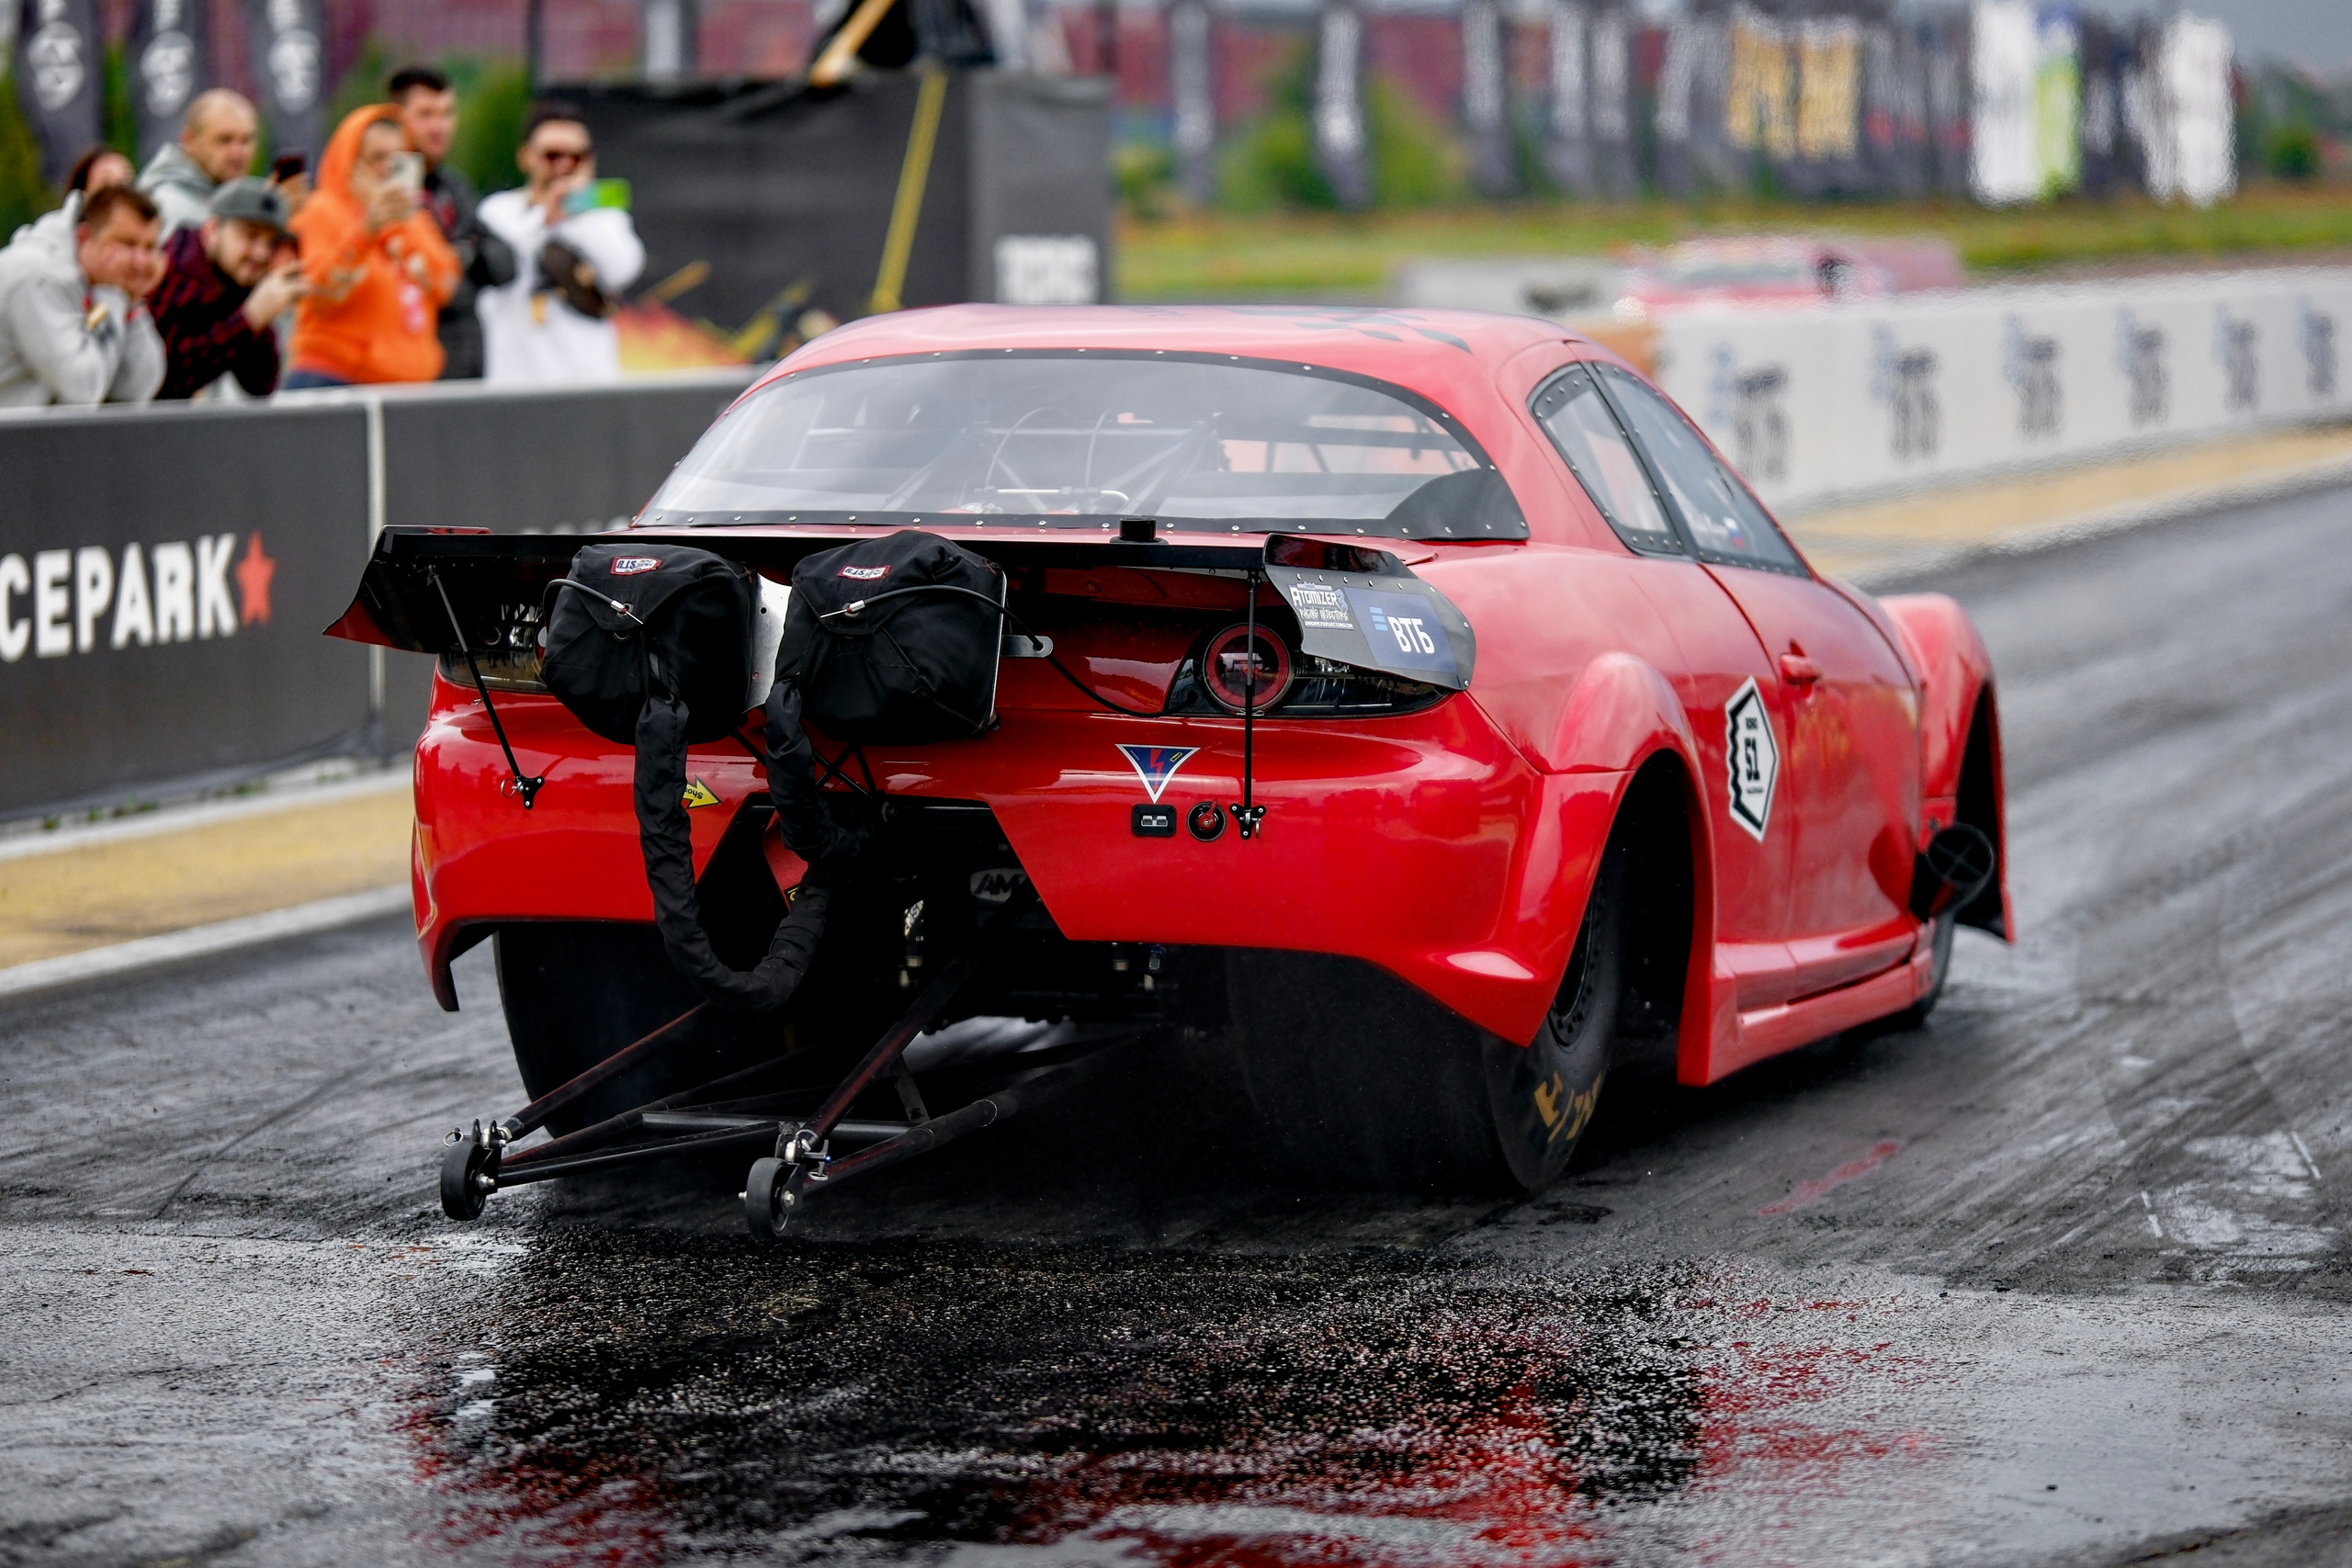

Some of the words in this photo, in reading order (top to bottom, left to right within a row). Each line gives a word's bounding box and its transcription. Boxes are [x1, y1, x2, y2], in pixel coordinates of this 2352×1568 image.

[1289, 587, 1341, 611] ATOMIZER
[1299, 606, 1318, 620] RACING
[1319, 607, 1349, 622] INJECTORS
[1386, 615, 1435, 654] ВТБ
